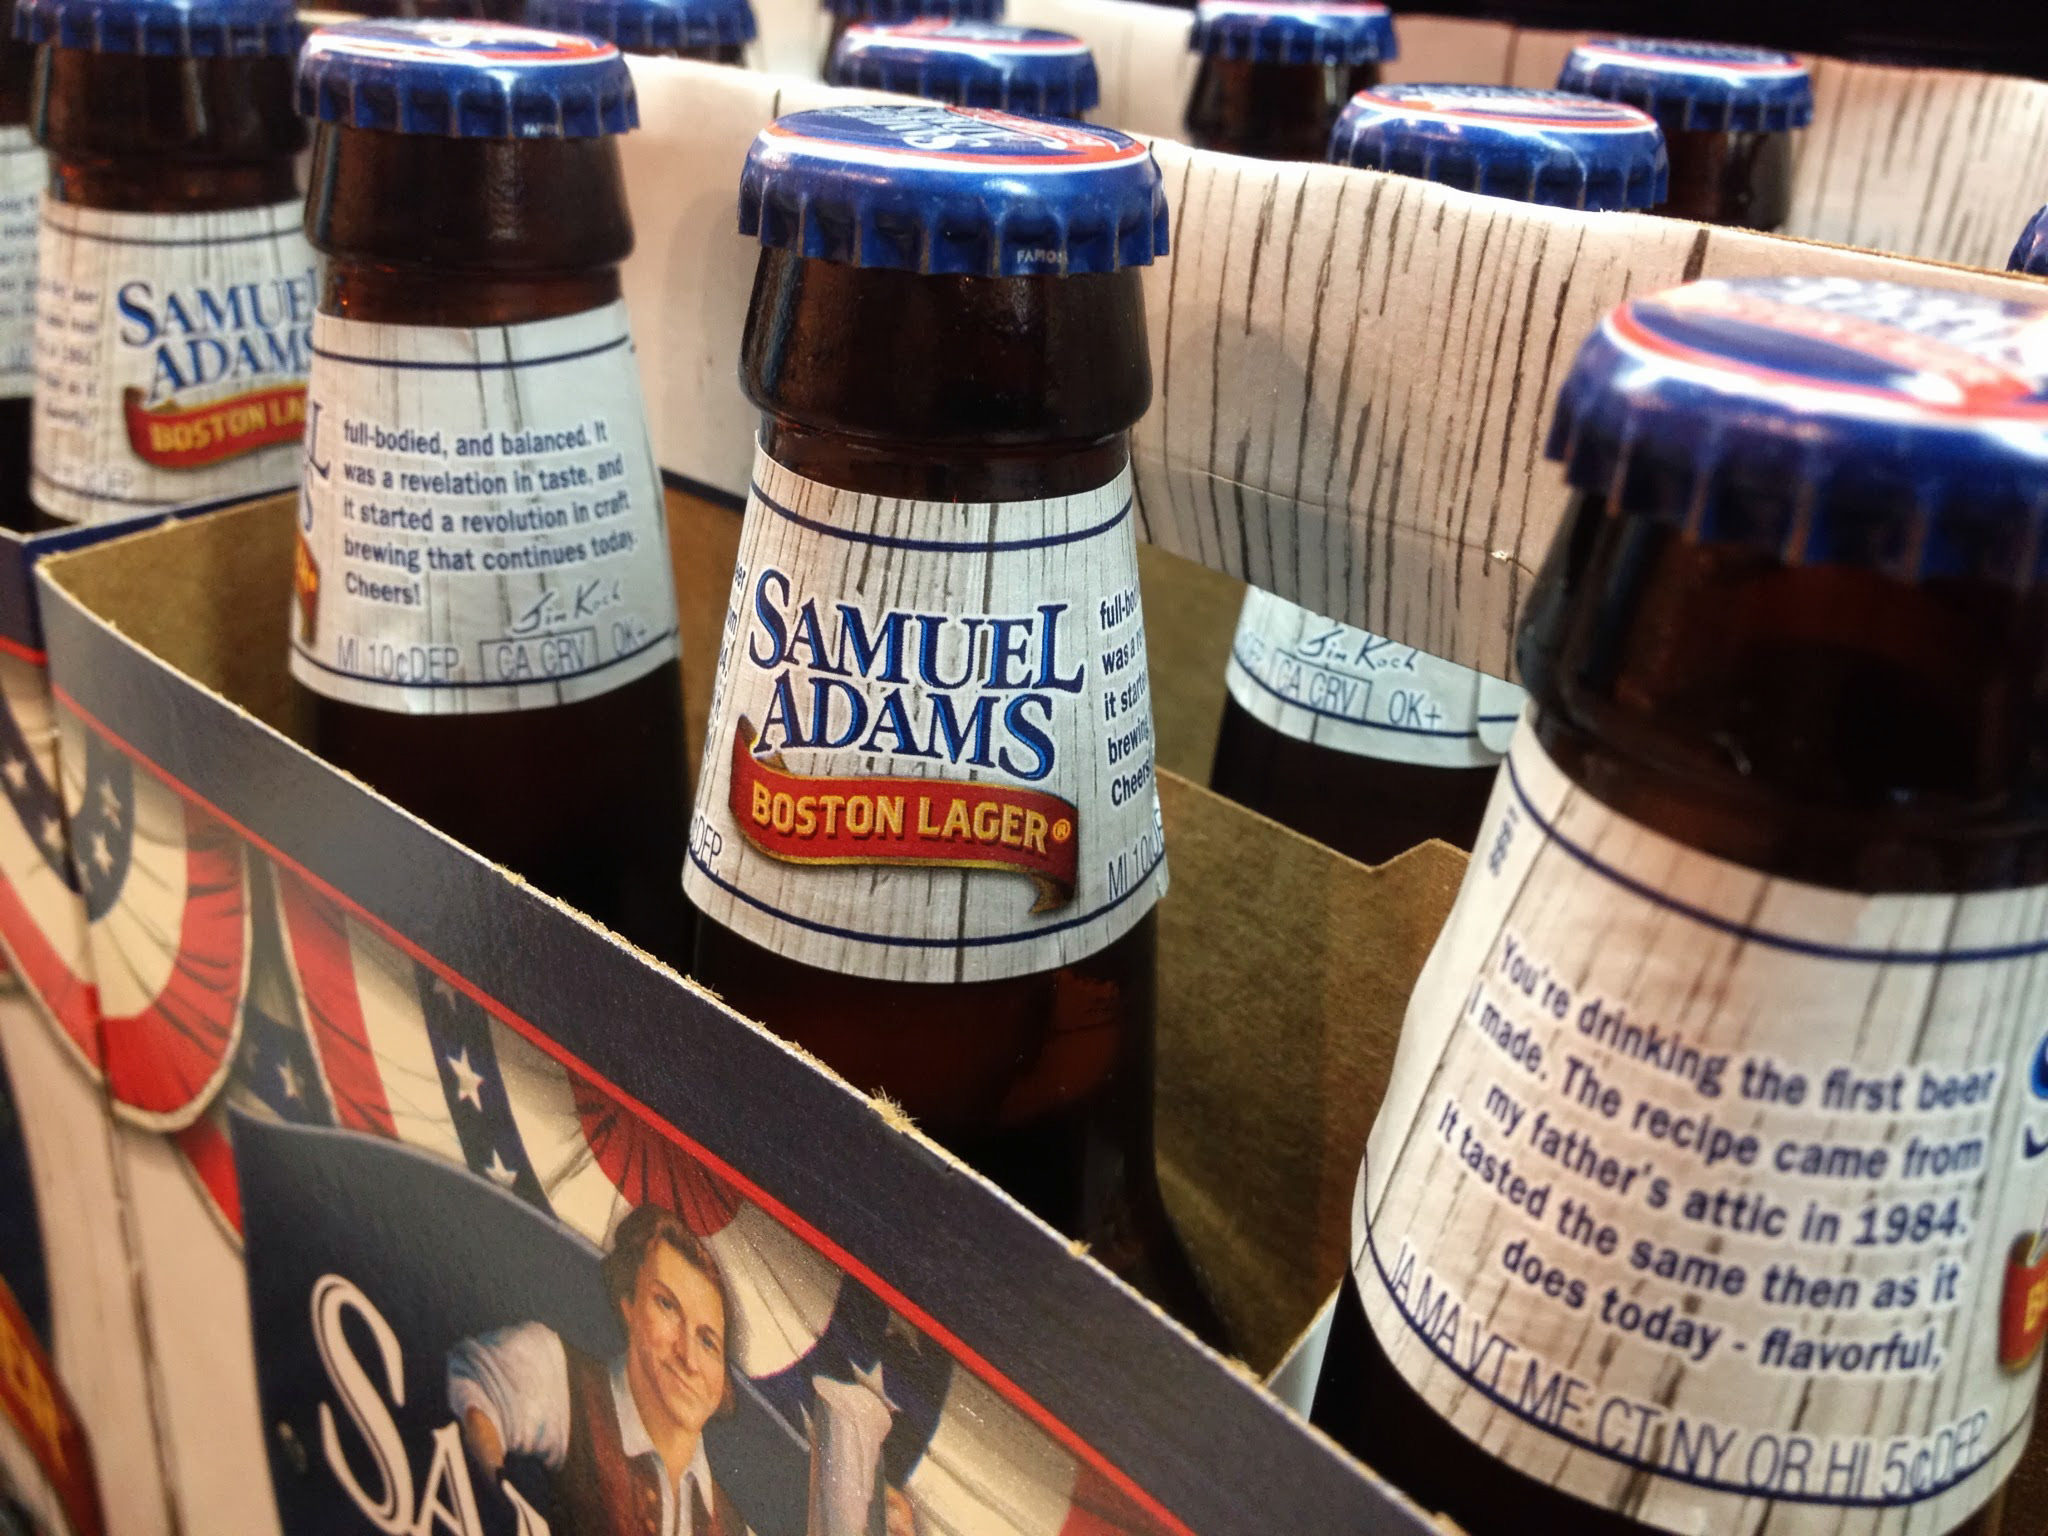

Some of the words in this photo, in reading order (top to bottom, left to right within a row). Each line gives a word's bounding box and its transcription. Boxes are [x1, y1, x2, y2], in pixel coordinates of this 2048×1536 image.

[150, 400, 266, 452] BOSTON
[344, 419, 448, 460] full-bodied,
[456, 434, 494, 456] and
[501, 424, 591, 456] balanced.
[594, 419, 607, 442] It
[344, 463, 376, 486] was
[382, 471, 393, 489] a
[401, 472, 507, 495] revelation
[513, 470, 533, 492] in
[538, 466, 593, 491] taste,
[597, 453, 624, 481] and
[344, 496, 354, 520] it
[361, 503, 434, 532] started
[442, 514, 454, 532] a
[461, 507, 568, 533] revolution
[572, 501, 590, 524] in
[594, 490, 630, 518] craft
[344, 534, 422, 574] brewing
[427, 547, 475, 571] that
[483, 543, 587, 570] continues
[345, 572, 420, 606] Cheers!
[748, 568, 1085, 694] SAMUEL
[1102, 643, 1129, 675] was
[1130, 637, 1136, 659] a
[338, 635, 359, 670] MI
[499, 646, 532, 682] CA
[540, 636, 587, 676] CRV
[752, 673, 1056, 782] ADAMS
[1104, 691, 1116, 720] it
[1309, 672, 1358, 718] CRV
[1388, 690, 1442, 729] OK+
[752, 780, 905, 838] BOSTON
[1108, 853, 1128, 900] MI
[1501, 935, 1570, 1018] You're
[1577, 998, 1728, 1097] drinking
[1740, 1057, 1807, 1106] the
[1822, 1067, 1905, 1112] first
[1917, 1069, 1996, 1111] beer
[1469, 981, 1483, 1015] I
[1479, 1002, 1547, 1081] made.
[1561, 1055, 1622, 1118] The
[1631, 1101, 1759, 1166] recipe
[1774, 1141, 1889, 1178] came
[1902, 1137, 1983, 1179] from
[1485, 1084, 1526, 1137] my
[1530, 1110, 1671, 1208] father's
[1683, 1189, 1787, 1237] attic
[1801, 1202, 1840, 1243] in
[1853, 1198, 1967, 1246] 1984.
[1438, 1099, 1459, 1143] It
[1460, 1126, 1551, 1220] tasted
[1557, 1198, 1619, 1255] the
[1630, 1239, 1746, 1295] same
[1762, 1265, 1860, 1308] then
[1873, 1277, 1918, 1309] as
[1933, 1262, 1960, 1303] it
[1503, 1238, 1587, 1309] does
[1601, 1287, 1721, 1361] today
[1760, 1327, 1941, 1373] flavorful,
[1415, 1274, 1461, 1357] MA
[1469, 1320, 1518, 1391] VT
[1598, 1395, 1661, 1460] CT
[1670, 1418, 1737, 1480] NY
[1747, 1435, 1813, 1494] OR
[1824, 1441, 1871, 1496] HI
